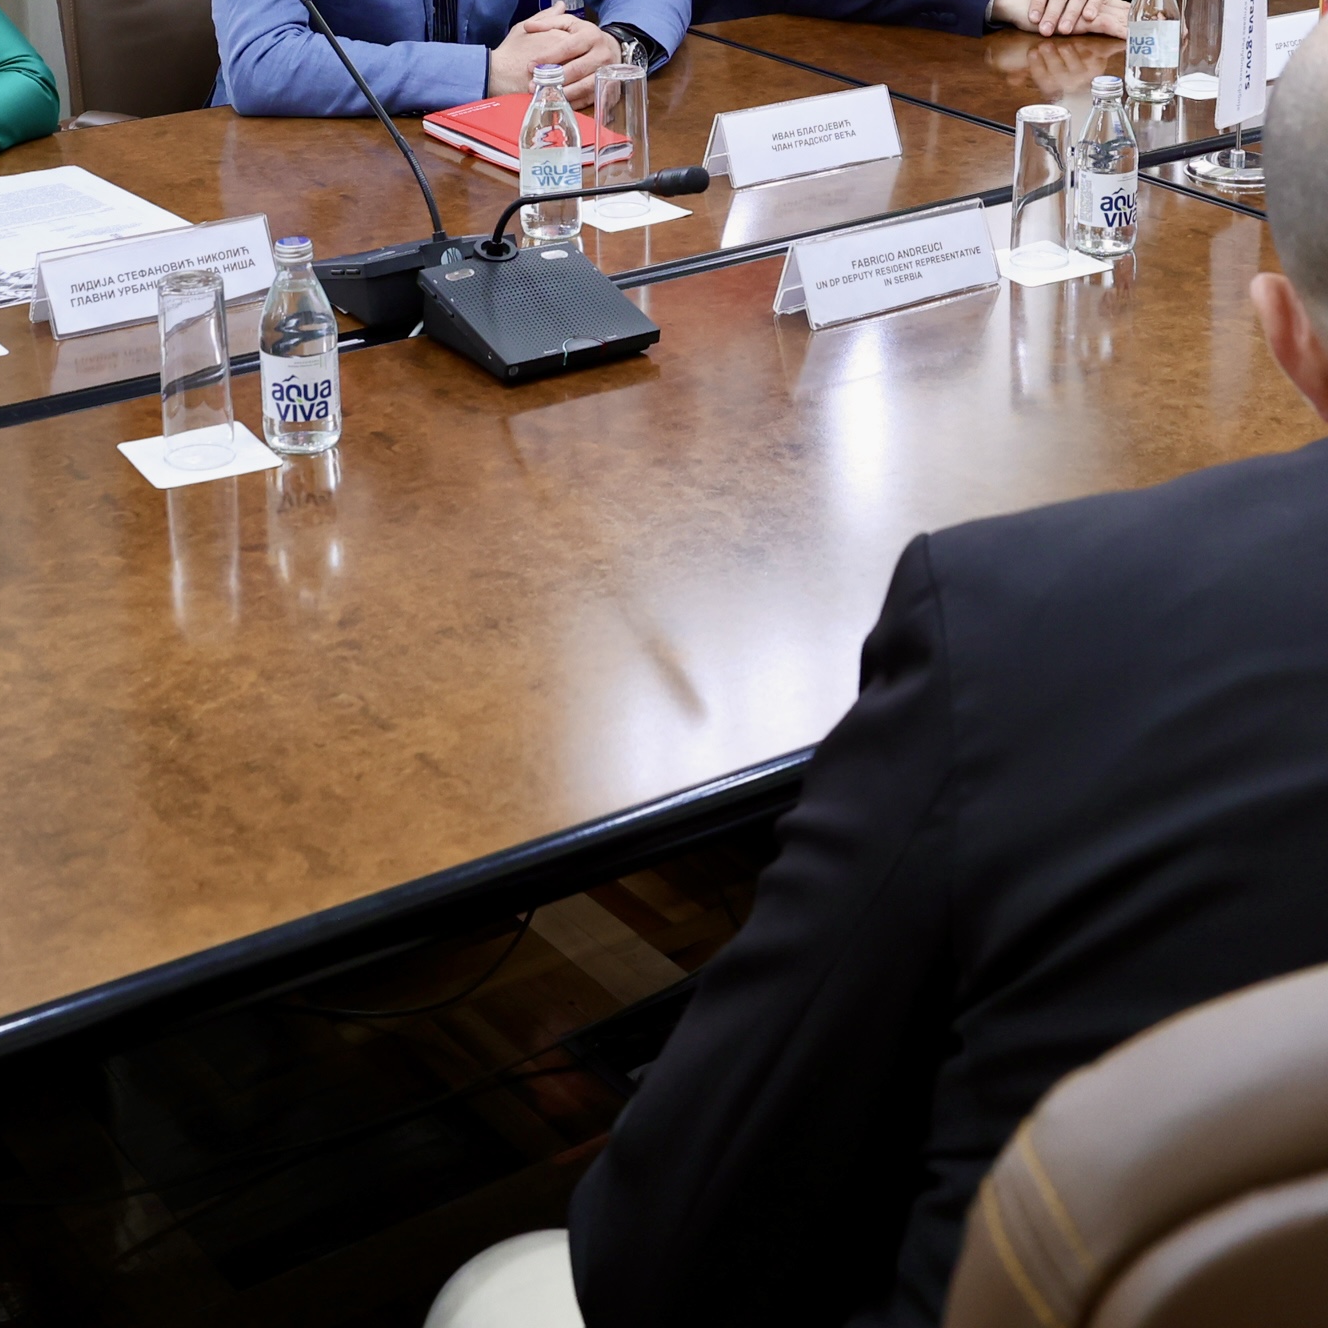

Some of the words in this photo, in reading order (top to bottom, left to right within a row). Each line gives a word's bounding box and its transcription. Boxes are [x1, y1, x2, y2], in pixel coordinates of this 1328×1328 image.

[771, 143, 794, 152] ЧЛАН
[794, 133, 833, 148] ГРАДСКОГ
[834, 129, 857, 141] ВЕЋА
[772, 130, 795, 141] ИВАН
[796, 119, 852, 137] БЛАГОЈЕВИЋ
[815, 280, 828, 290] UN
[829, 278, 841, 288] DP
[841, 270, 874, 285] DEPUTY
[874, 261, 914, 277] RESIDENT
[915, 245, 982, 268] REPRESENTATIVE
[851, 252, 896, 270] FABRICIO
[897, 241, 943, 260] ANDREUCI
[70, 272, 115, 294] ЛИДИЈА
[117, 257, 195, 284] СТЕФАНОВИЋ
[197, 246, 250, 266] НИКОЛИЋ
[70, 291, 116, 308] ГЛАВНИ
[223, 258, 256, 273] НИША
[883, 278, 893, 287] IN
[894, 270, 924, 285] SERBIA
[275, 400, 329, 422] viva
